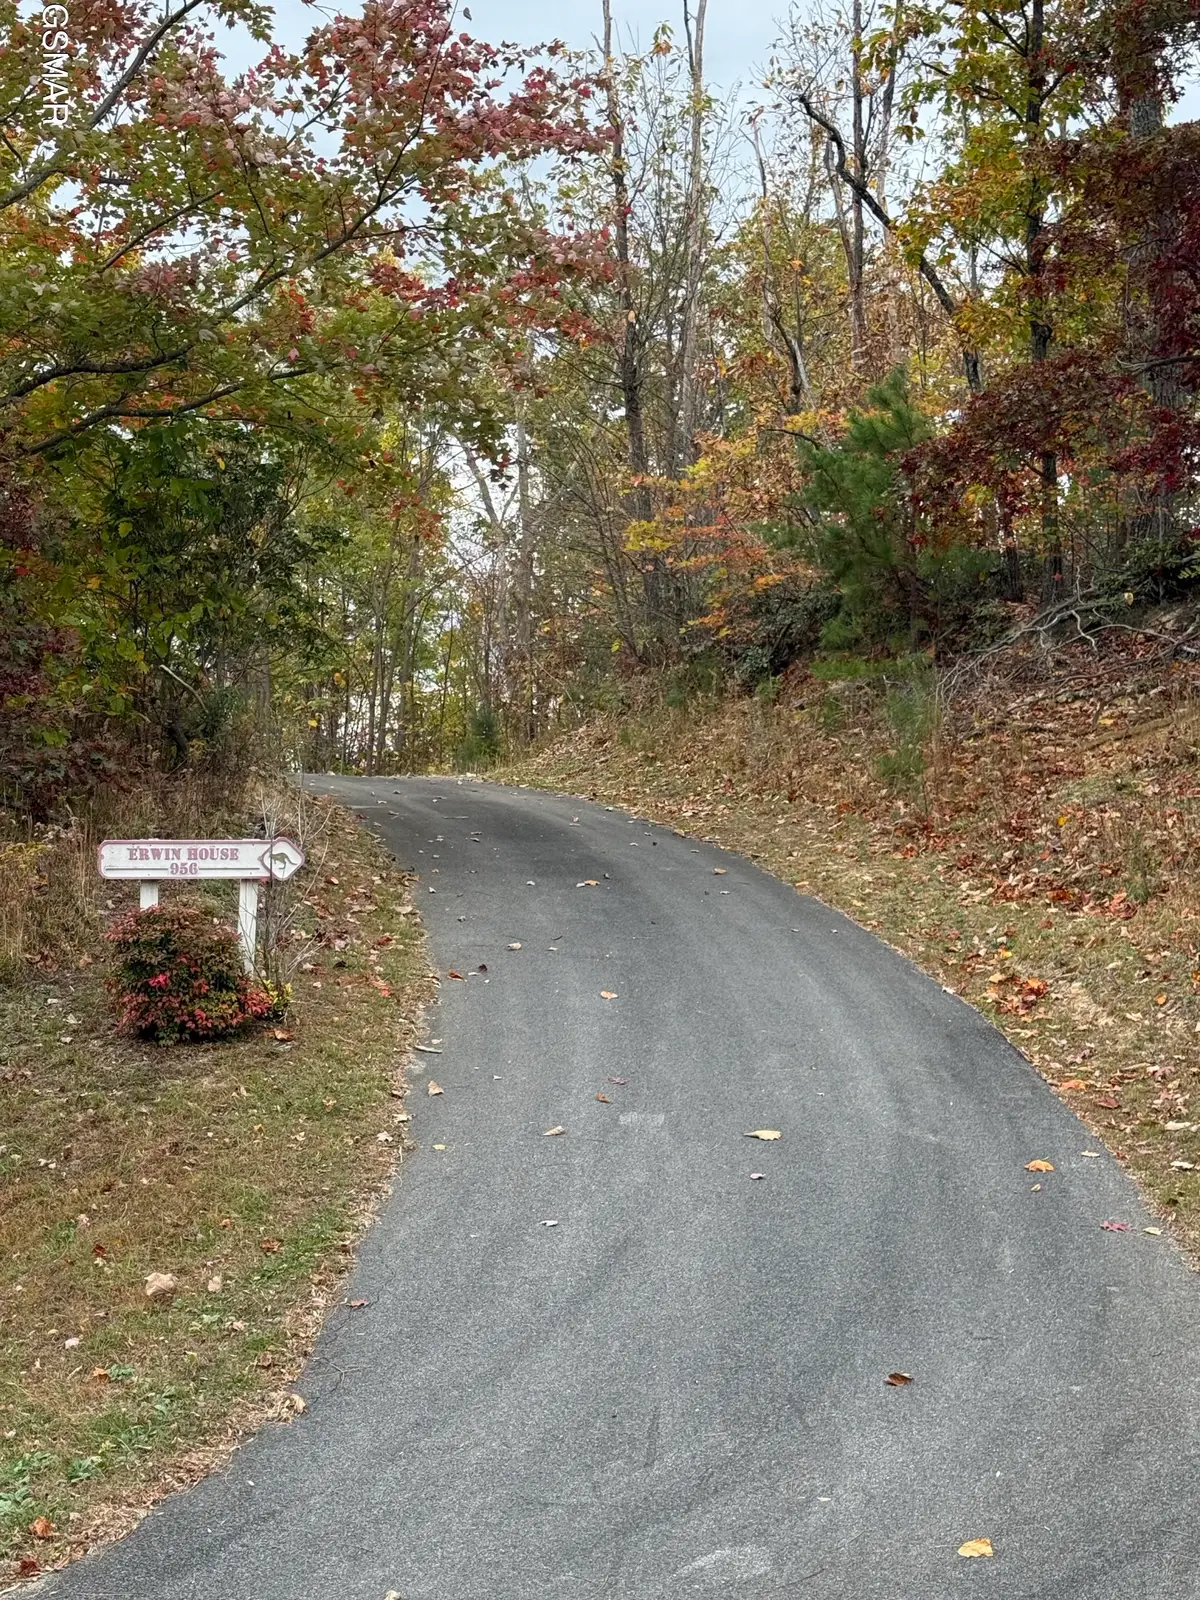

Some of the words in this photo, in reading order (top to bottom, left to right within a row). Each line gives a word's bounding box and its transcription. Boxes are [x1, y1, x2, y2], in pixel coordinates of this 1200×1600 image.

[128, 847, 181, 861] ERWIN
[187, 847, 239, 861] HOUSE
[170, 862, 198, 875] 956
